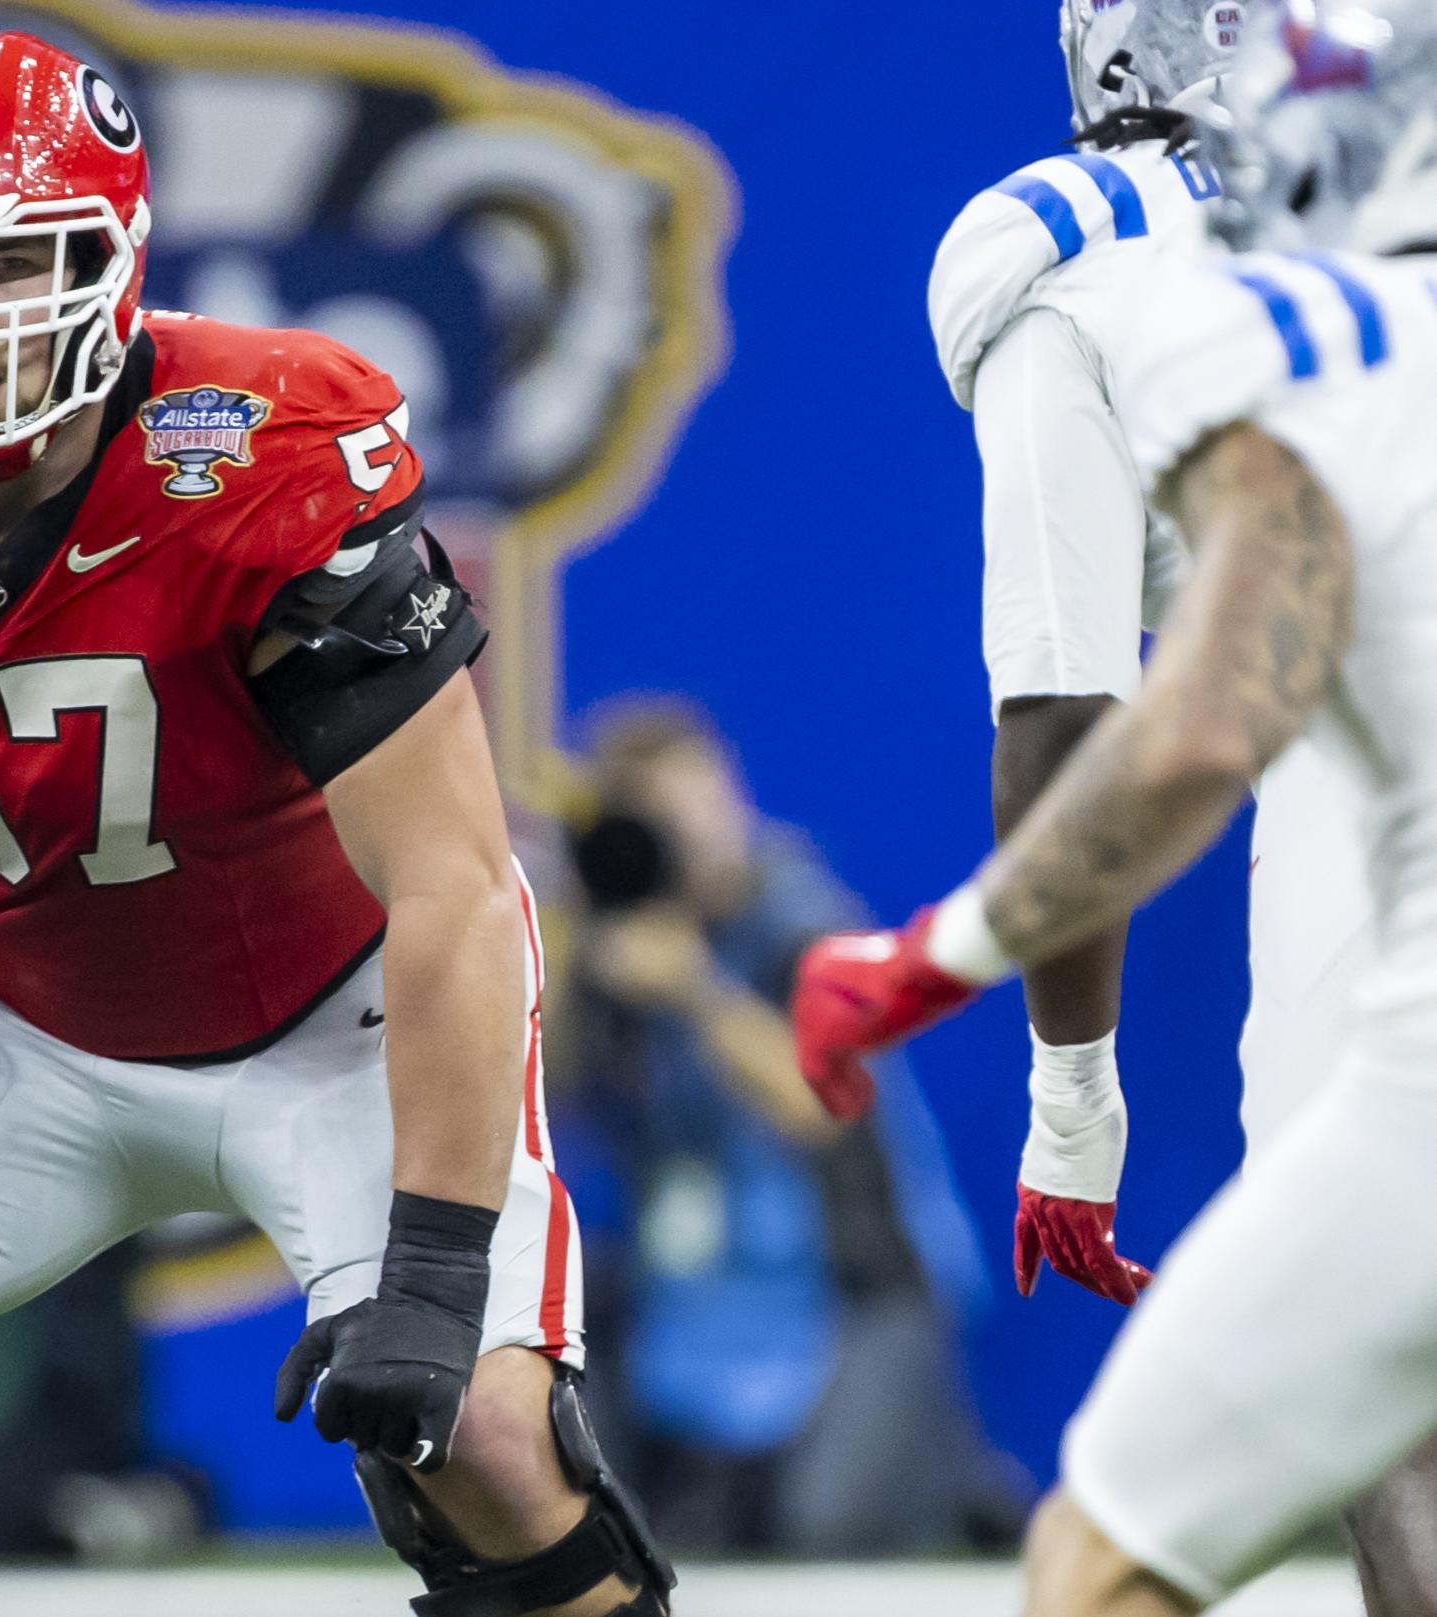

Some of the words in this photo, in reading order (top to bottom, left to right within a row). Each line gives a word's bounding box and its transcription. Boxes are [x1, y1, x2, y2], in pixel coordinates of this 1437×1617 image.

[92, 78, 129, 131] G
[156, 407, 244, 427] Allstate
[336, 400, 410, 492] 5
